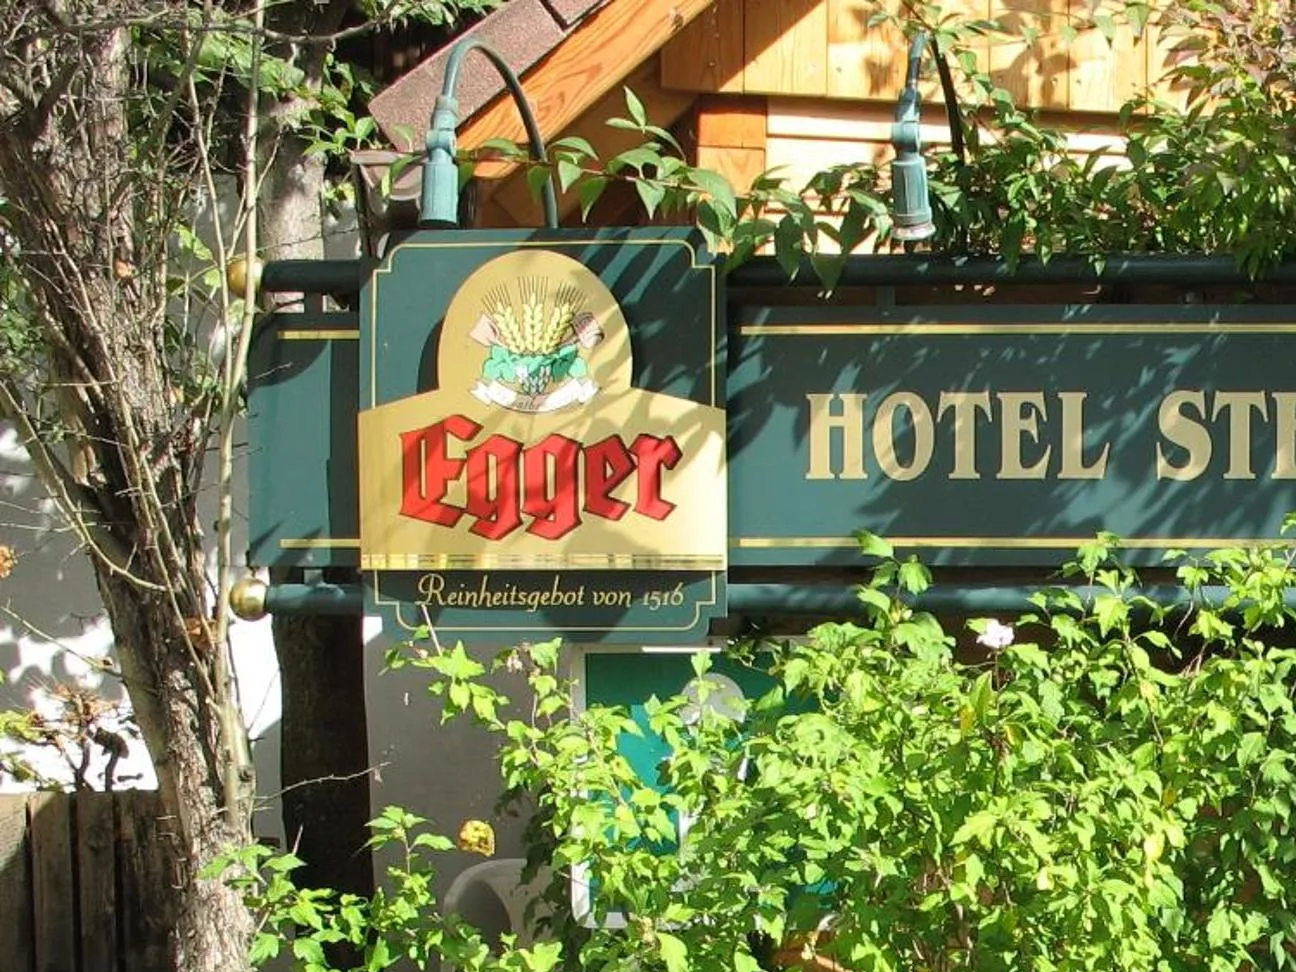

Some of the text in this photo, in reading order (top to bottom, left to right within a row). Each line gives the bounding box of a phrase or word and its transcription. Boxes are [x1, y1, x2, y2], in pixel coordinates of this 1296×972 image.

[399, 413, 684, 541] Egger
[806, 391, 1110, 481] HOTEL
[414, 573, 685, 613] Reinheitsgebot von 1516
